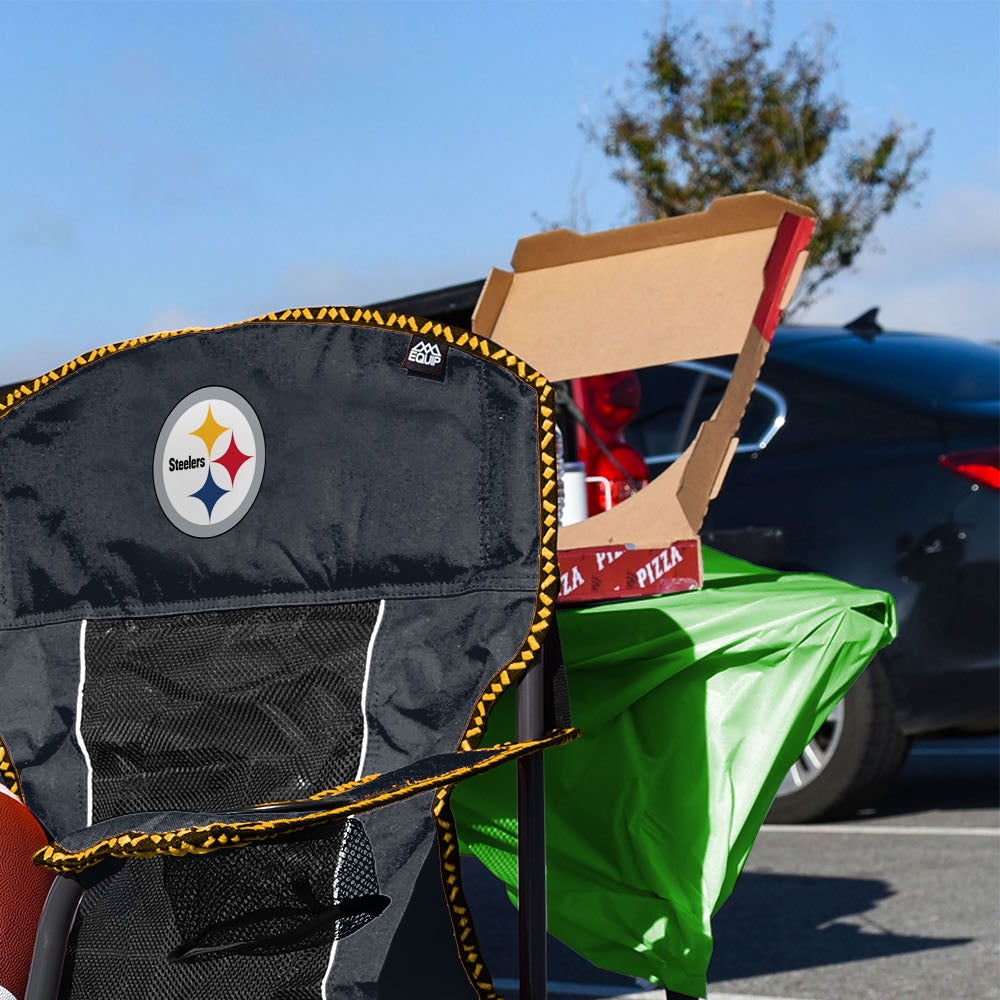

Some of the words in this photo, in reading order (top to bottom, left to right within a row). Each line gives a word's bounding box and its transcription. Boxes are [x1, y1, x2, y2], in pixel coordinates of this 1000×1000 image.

[408, 350, 442, 366] EQUIP
[168, 455, 206, 472] Steelers
[636, 546, 683, 588] PIZZA
